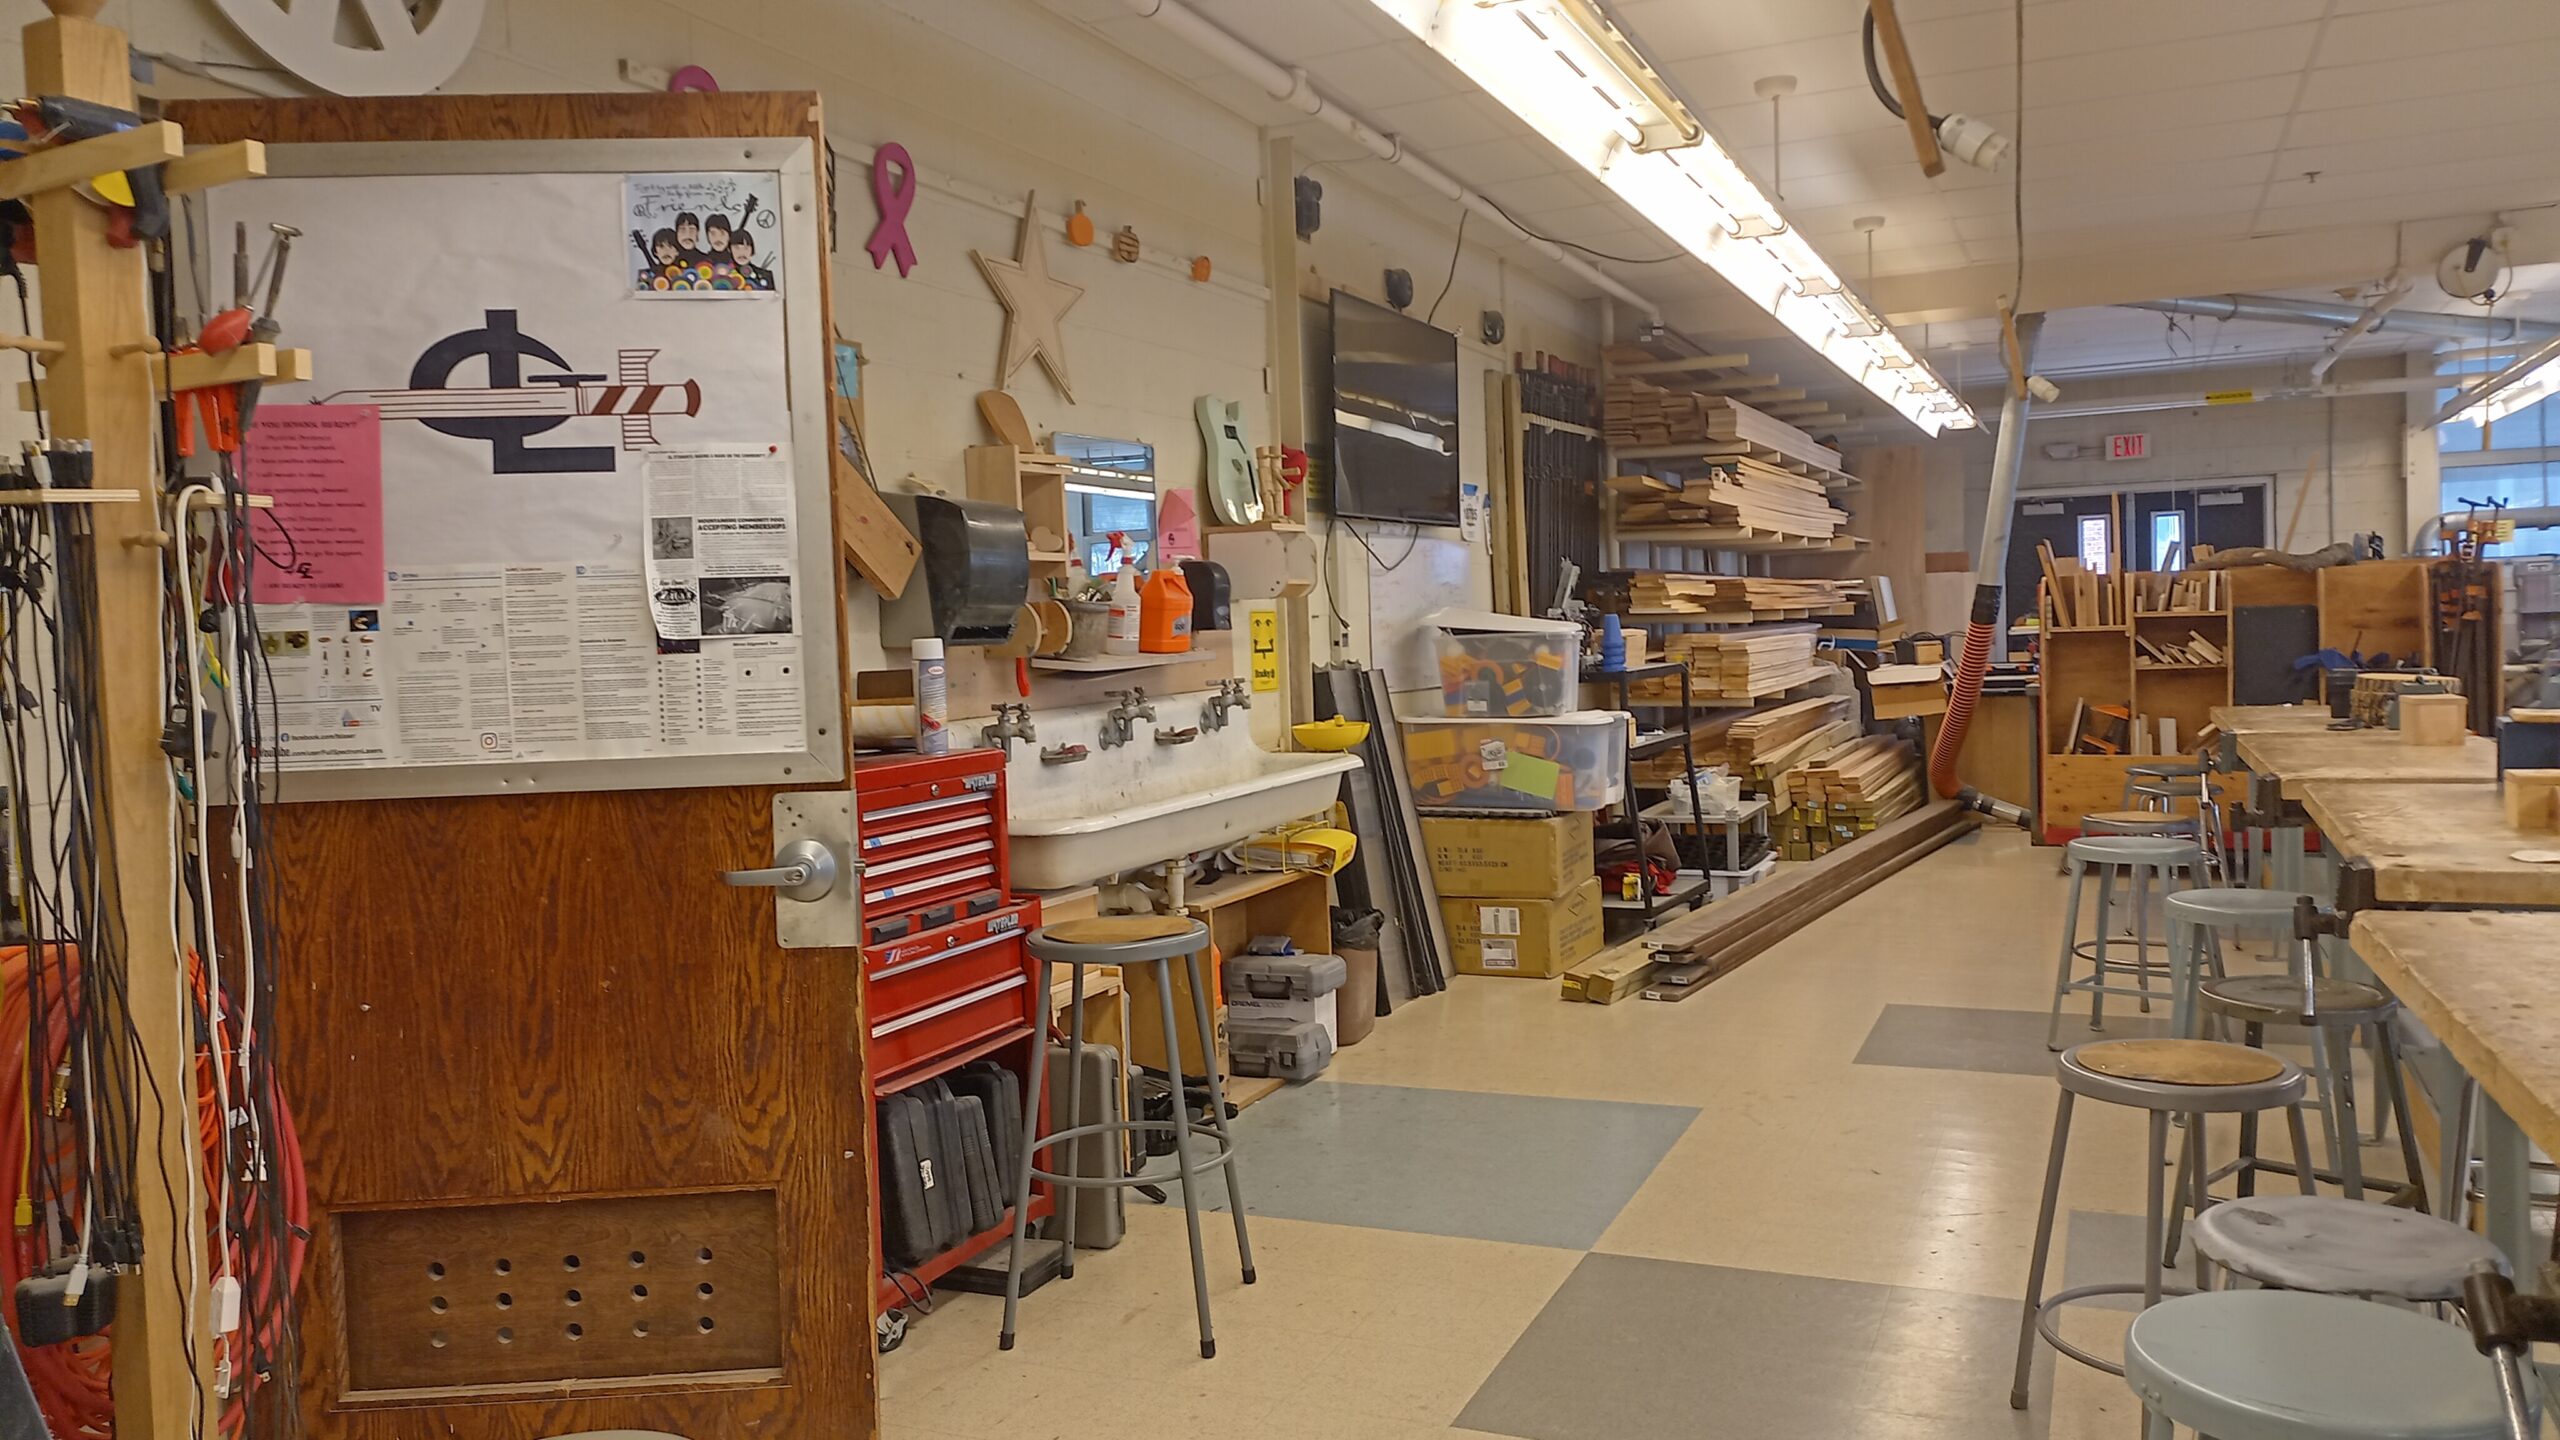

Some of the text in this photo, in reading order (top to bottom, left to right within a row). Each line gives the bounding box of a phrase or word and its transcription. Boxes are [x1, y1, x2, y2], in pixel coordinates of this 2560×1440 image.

[640, 194, 743, 217] Friends
[2113, 435, 2145, 458] EXIT
[738, 523, 787, 531] MEMBERSHIPS
